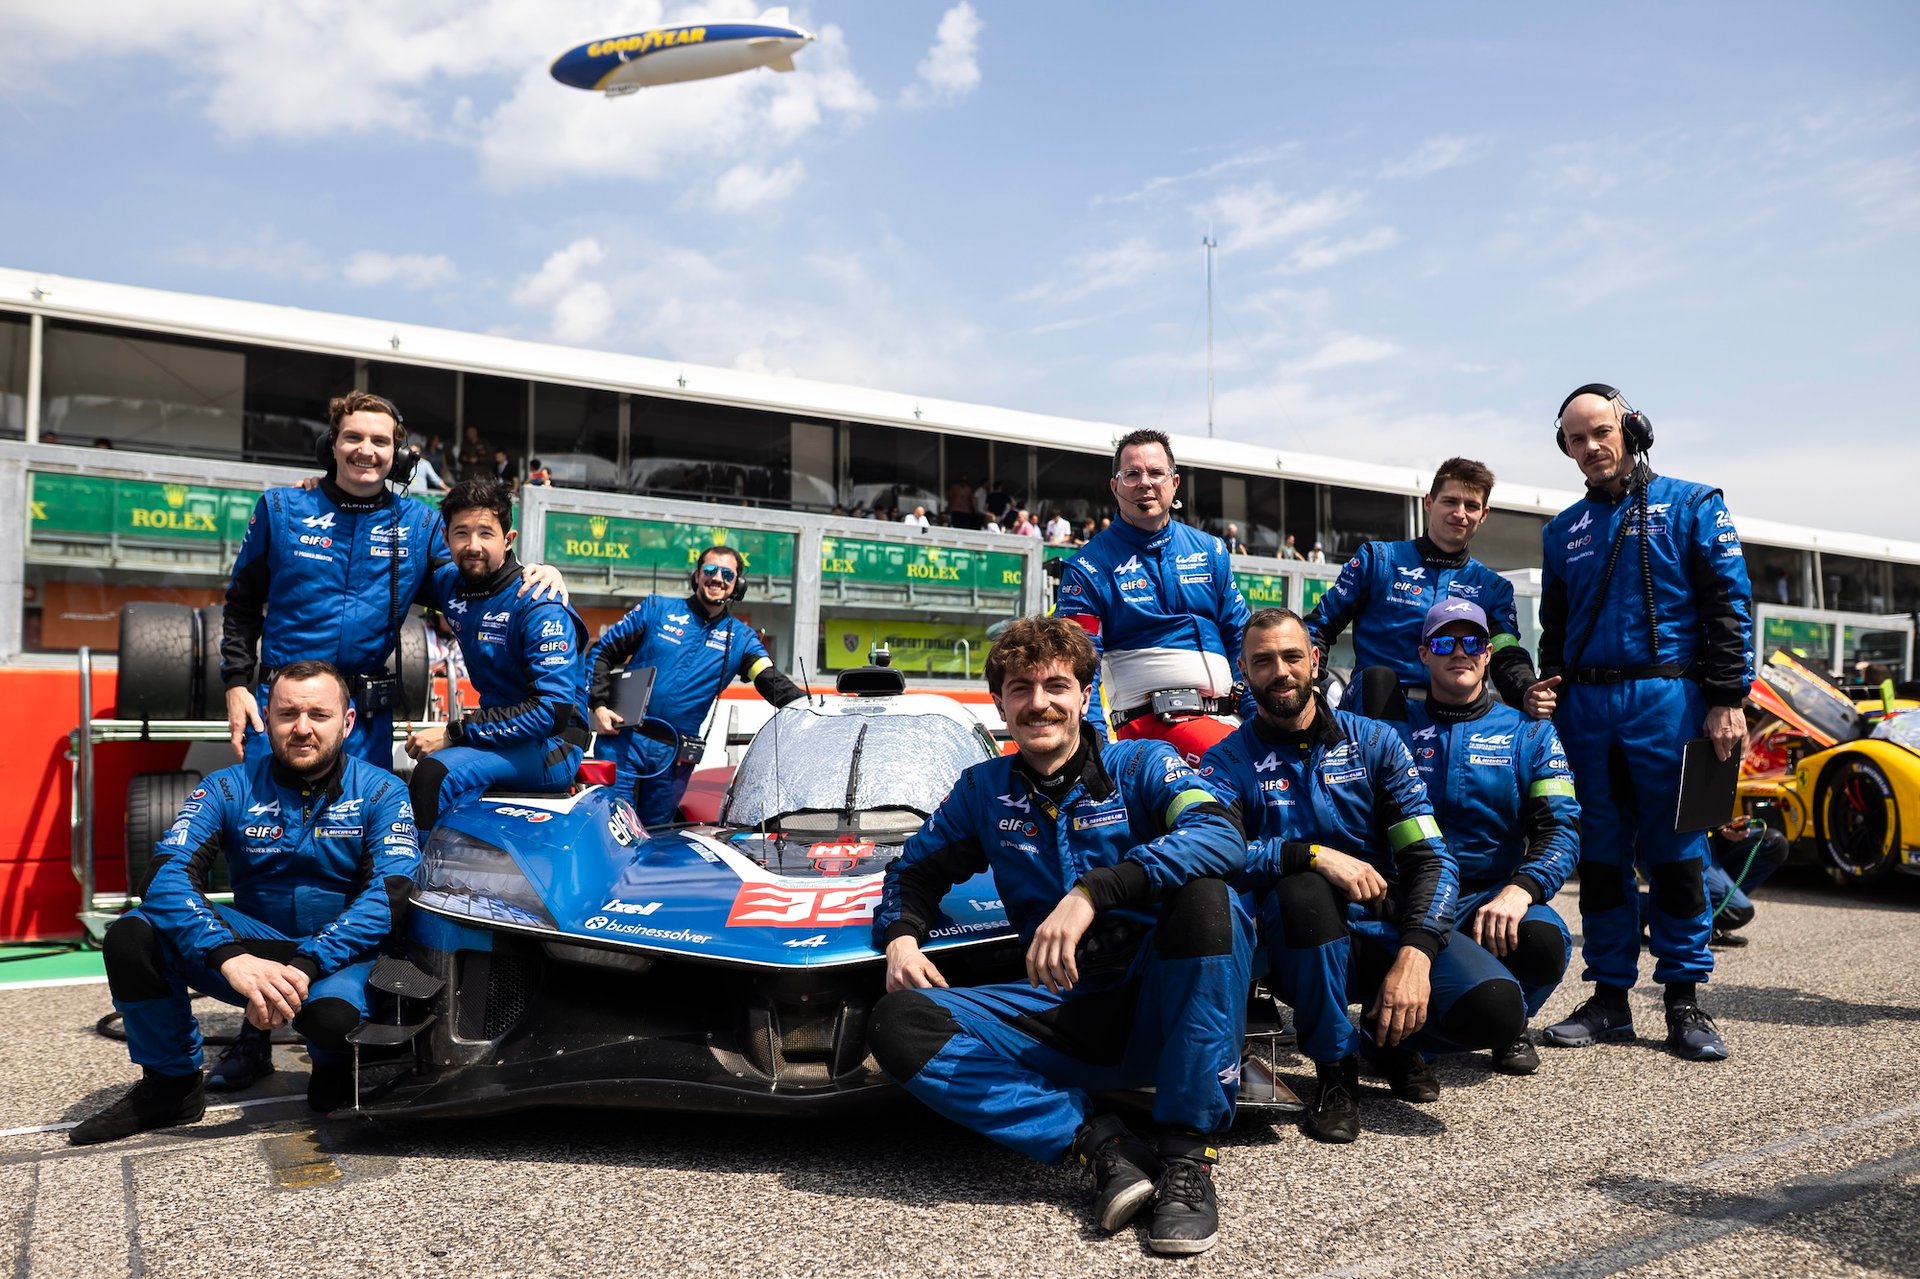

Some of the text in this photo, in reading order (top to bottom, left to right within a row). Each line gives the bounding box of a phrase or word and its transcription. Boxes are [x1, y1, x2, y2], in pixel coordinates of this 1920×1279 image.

[587, 28, 706, 57] GOODYEAR
[132, 508, 217, 531] ROLEX
[566, 539, 630, 559] ROLEX
[822, 558, 855, 573] LEX
[907, 564, 960, 580] ROLEX
[371, 781, 392, 805] Sabelt
[814, 845, 869, 856] HY
[602, 900, 663, 916] ixell
[606, 920, 712, 944] businessolver
